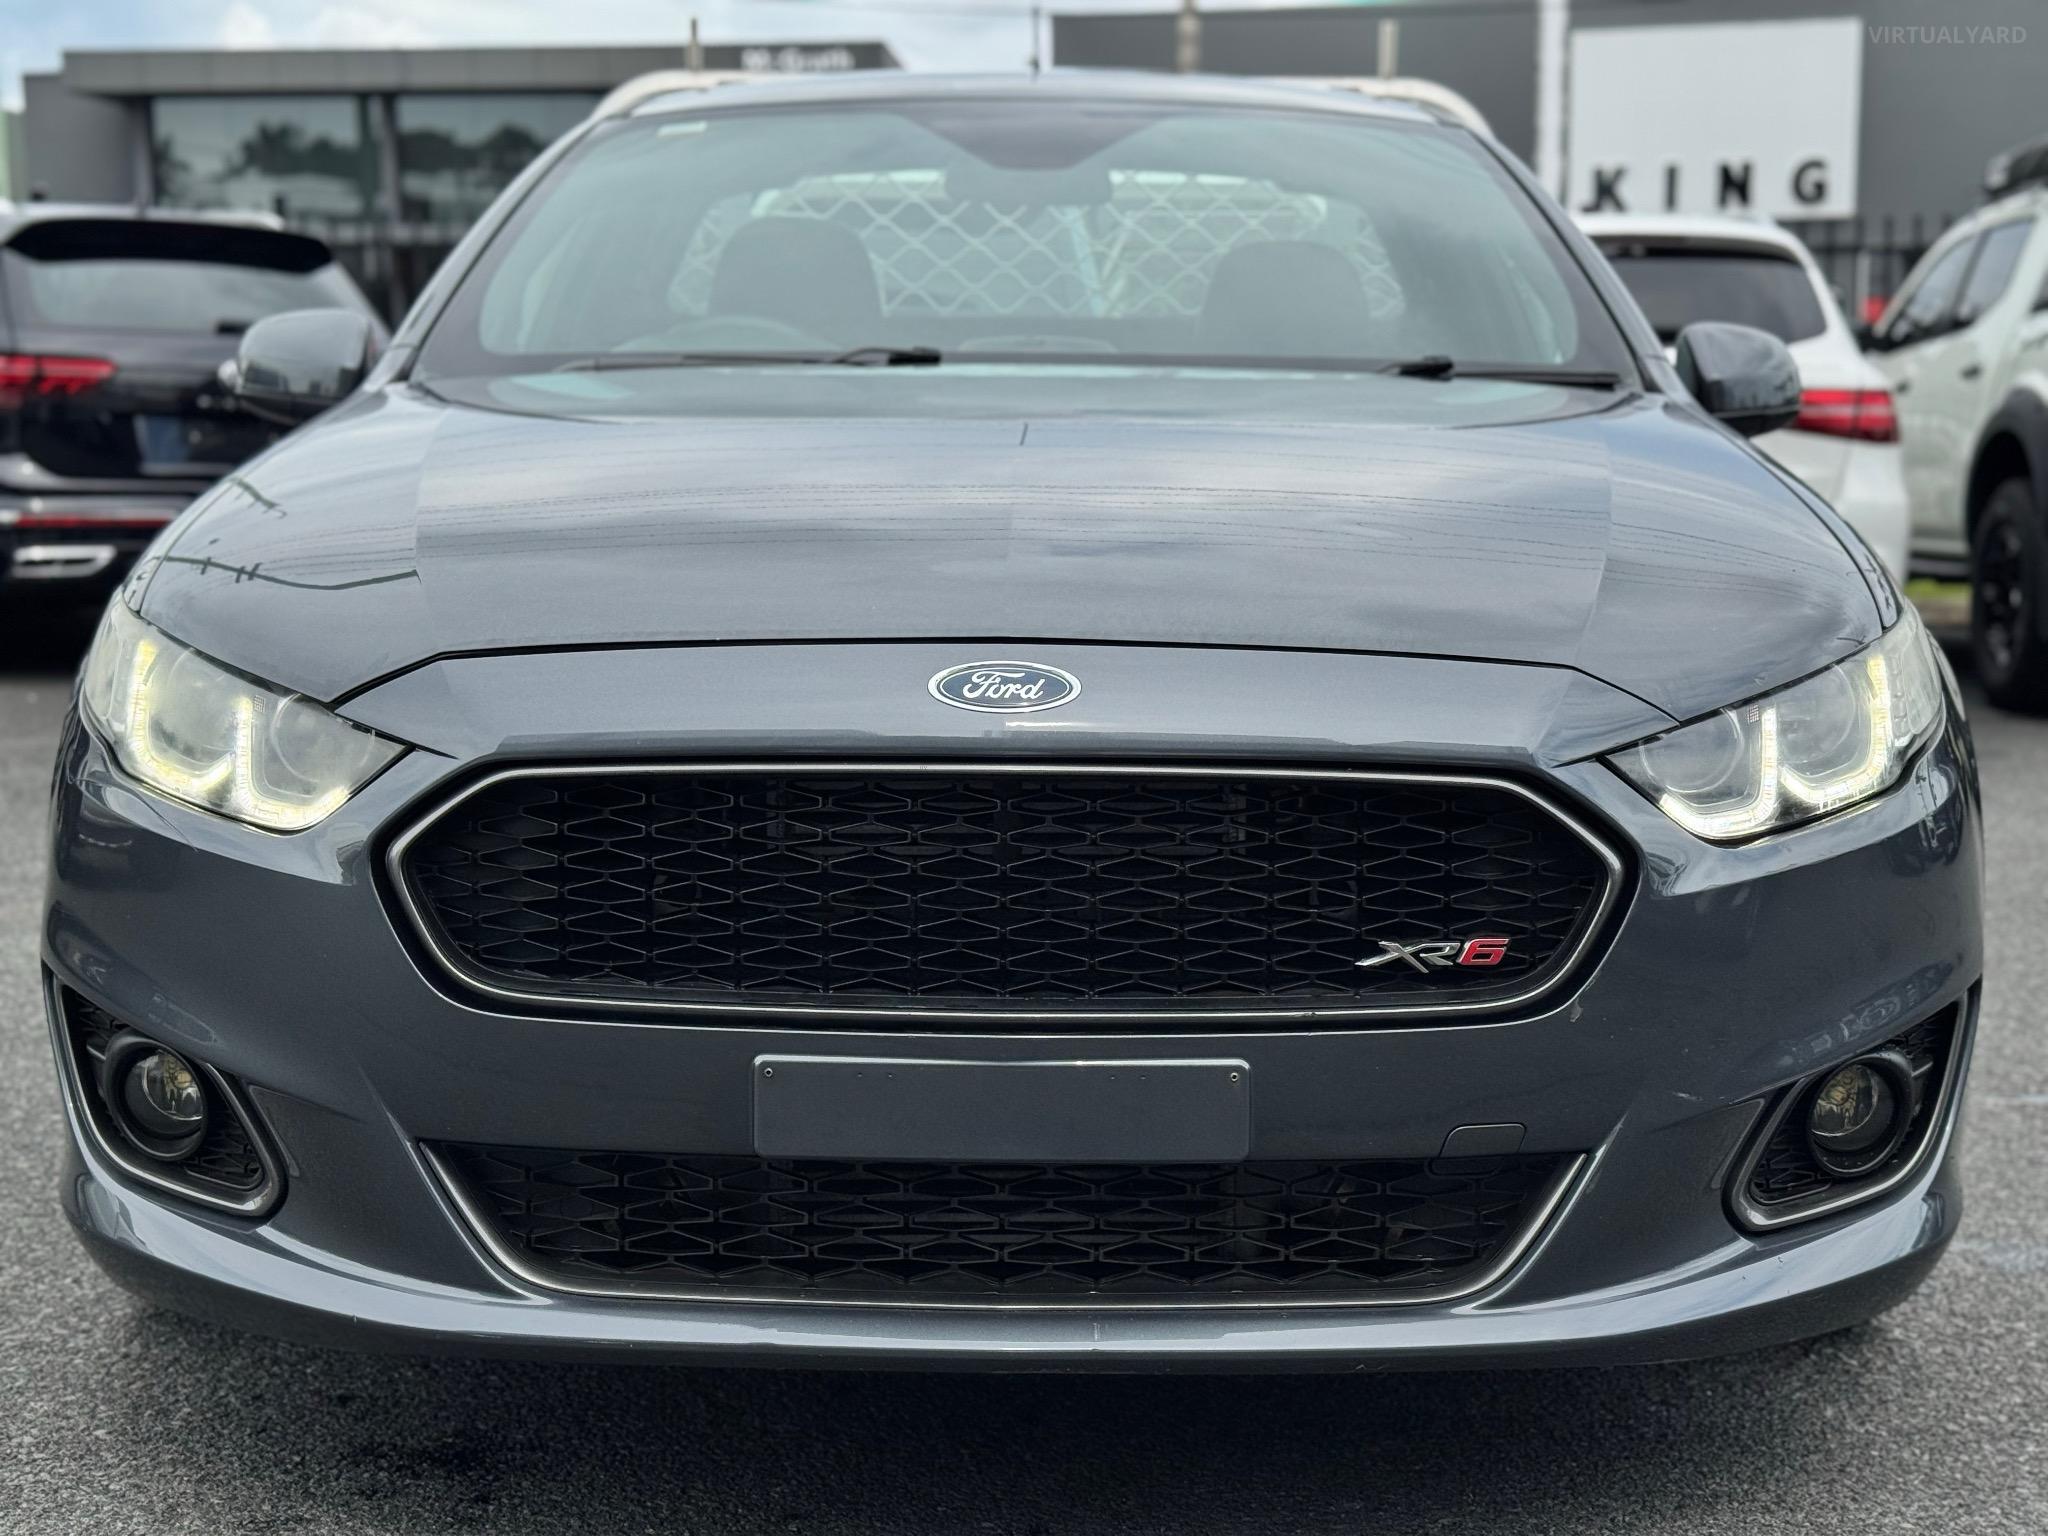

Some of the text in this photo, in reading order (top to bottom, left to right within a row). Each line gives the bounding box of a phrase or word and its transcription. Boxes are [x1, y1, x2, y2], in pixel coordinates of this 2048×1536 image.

[1586, 160, 1827, 212] KING
[962, 671, 1046, 699] Ford
[1354, 938, 1511, 973] XR6
